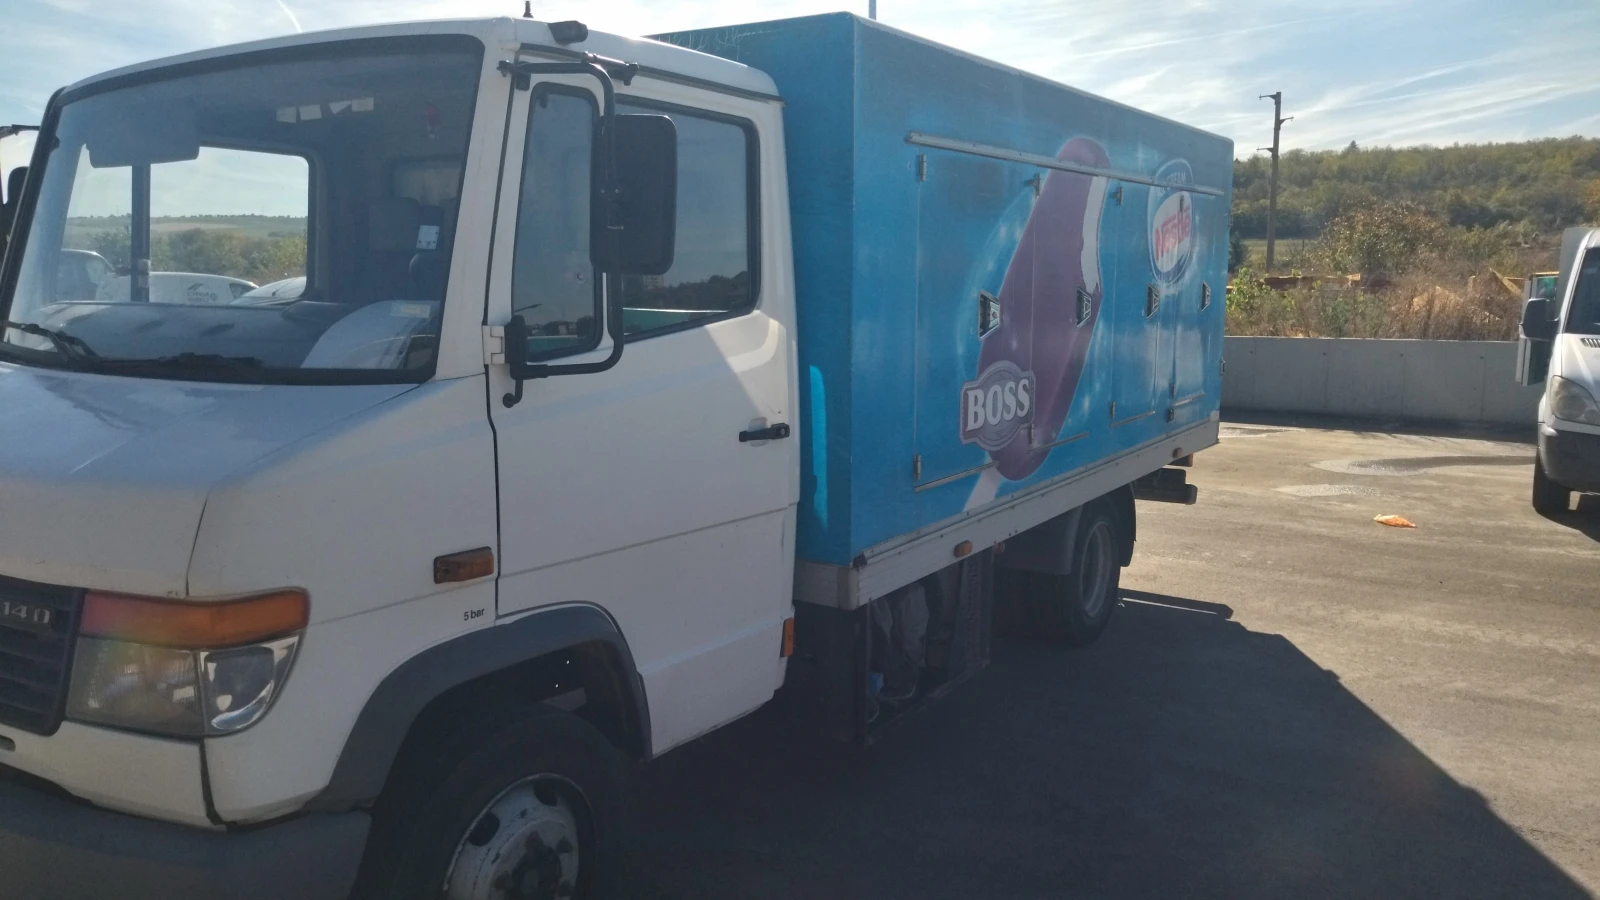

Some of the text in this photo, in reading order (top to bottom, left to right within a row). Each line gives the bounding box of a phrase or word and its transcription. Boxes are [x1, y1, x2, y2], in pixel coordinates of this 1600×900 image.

[965, 378, 1030, 432] BOSS
[463, 608, 486, 621] 5 bar
